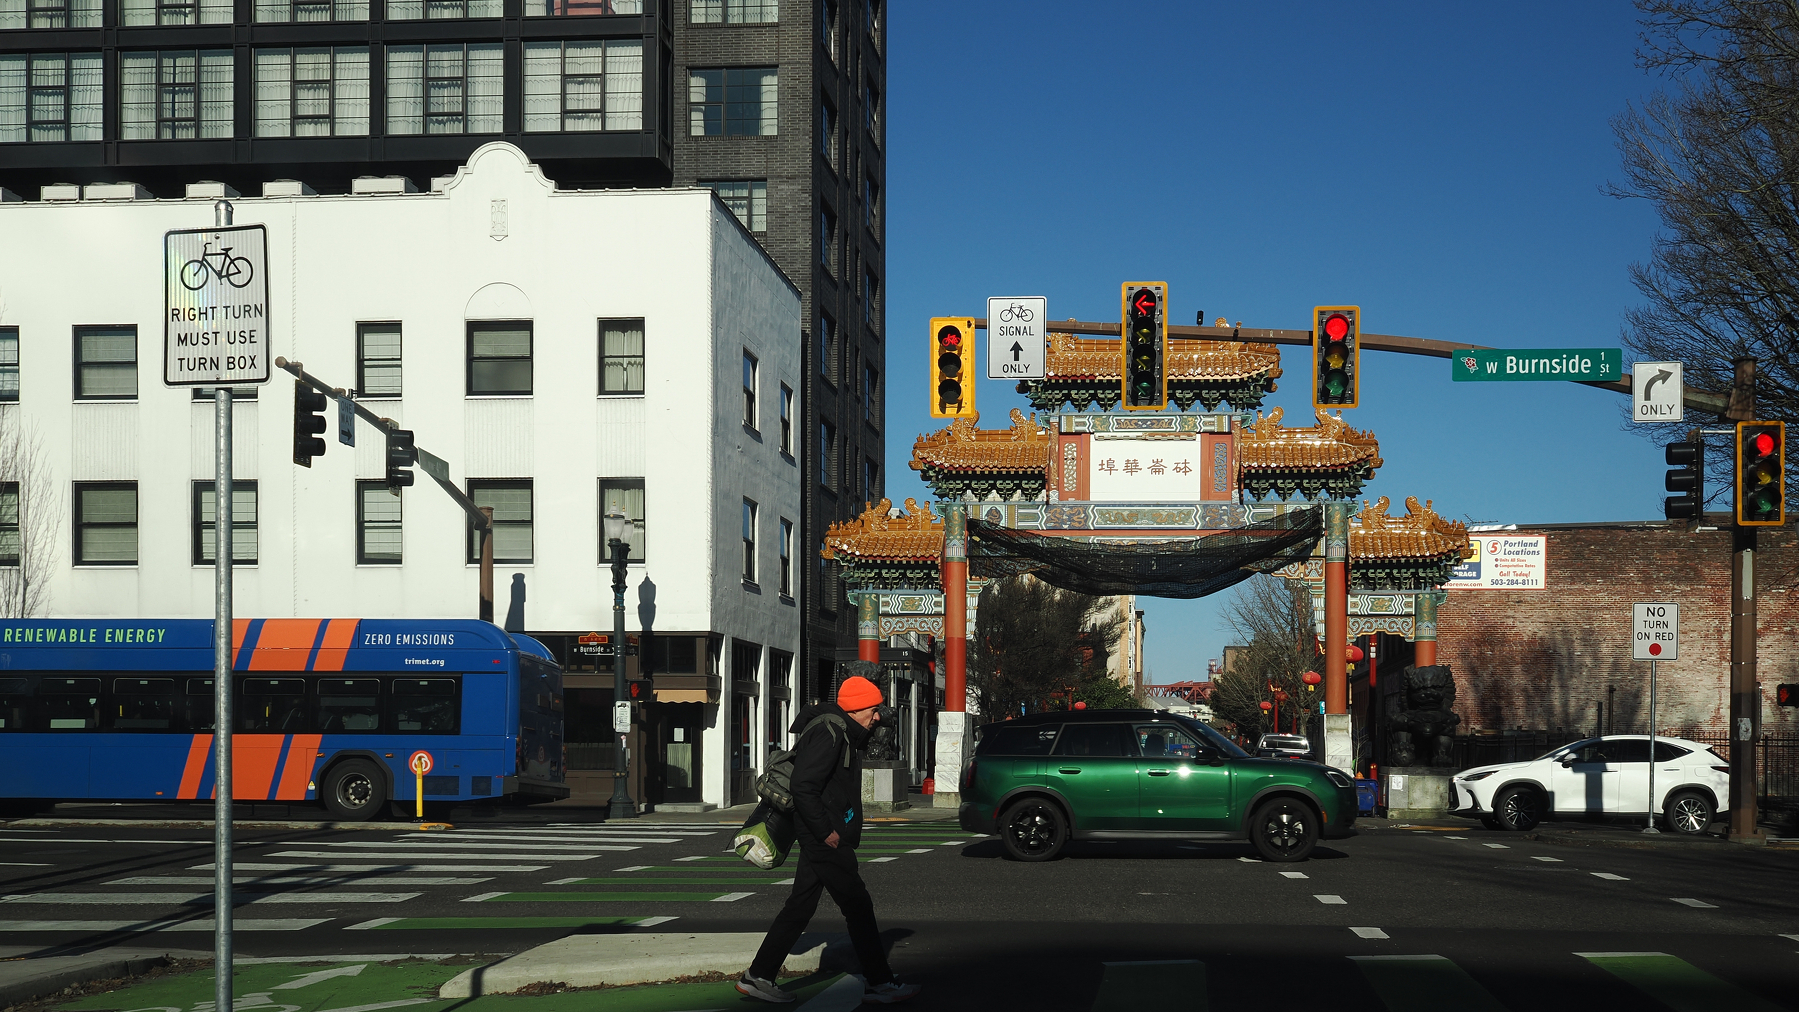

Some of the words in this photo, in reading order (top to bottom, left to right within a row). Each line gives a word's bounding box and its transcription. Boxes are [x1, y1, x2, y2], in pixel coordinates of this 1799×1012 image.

[171, 306, 217, 323] RIGHT
[224, 303, 264, 319] TURN
[998, 325, 1035, 336] SIGNAL
[177, 331, 220, 347] MUST
[227, 329, 258, 345] USE
[1600, 352, 1605, 361] 1
[177, 356, 220, 372] TURN
[226, 354, 258, 371] BOX
[1002, 362, 1031, 374] ONLY
[1486, 361, 1498, 374] W
[1506, 354, 1592, 374] Burnside
[1600, 363, 1610, 374] St
[341, 401, 352, 414] ONE
[1640, 403, 1675, 416] ONLY
[341, 413, 352, 427] WAY
[1490, 542, 1498, 553] 5
[1503, 540, 1539, 548] Portland
[1503, 548, 1540, 556] Locations
[1512, 570, 1531, 578] Today!
[1490, 578, 1538, 586] 503-284-8111
[1646, 606, 1666, 618] NO
[1643, 620, 1669, 630] TURN
[4, 628, 98, 643] RENEWABLE
[105, 628, 166, 643] ENERGY
[364, 633, 391, 646] ZERO
[396, 633, 456, 646] EMISSIONS
[1636, 632, 1652, 641] ON
[1655, 632, 1675, 641] RED
[405, 658, 445, 667] trimet.org
